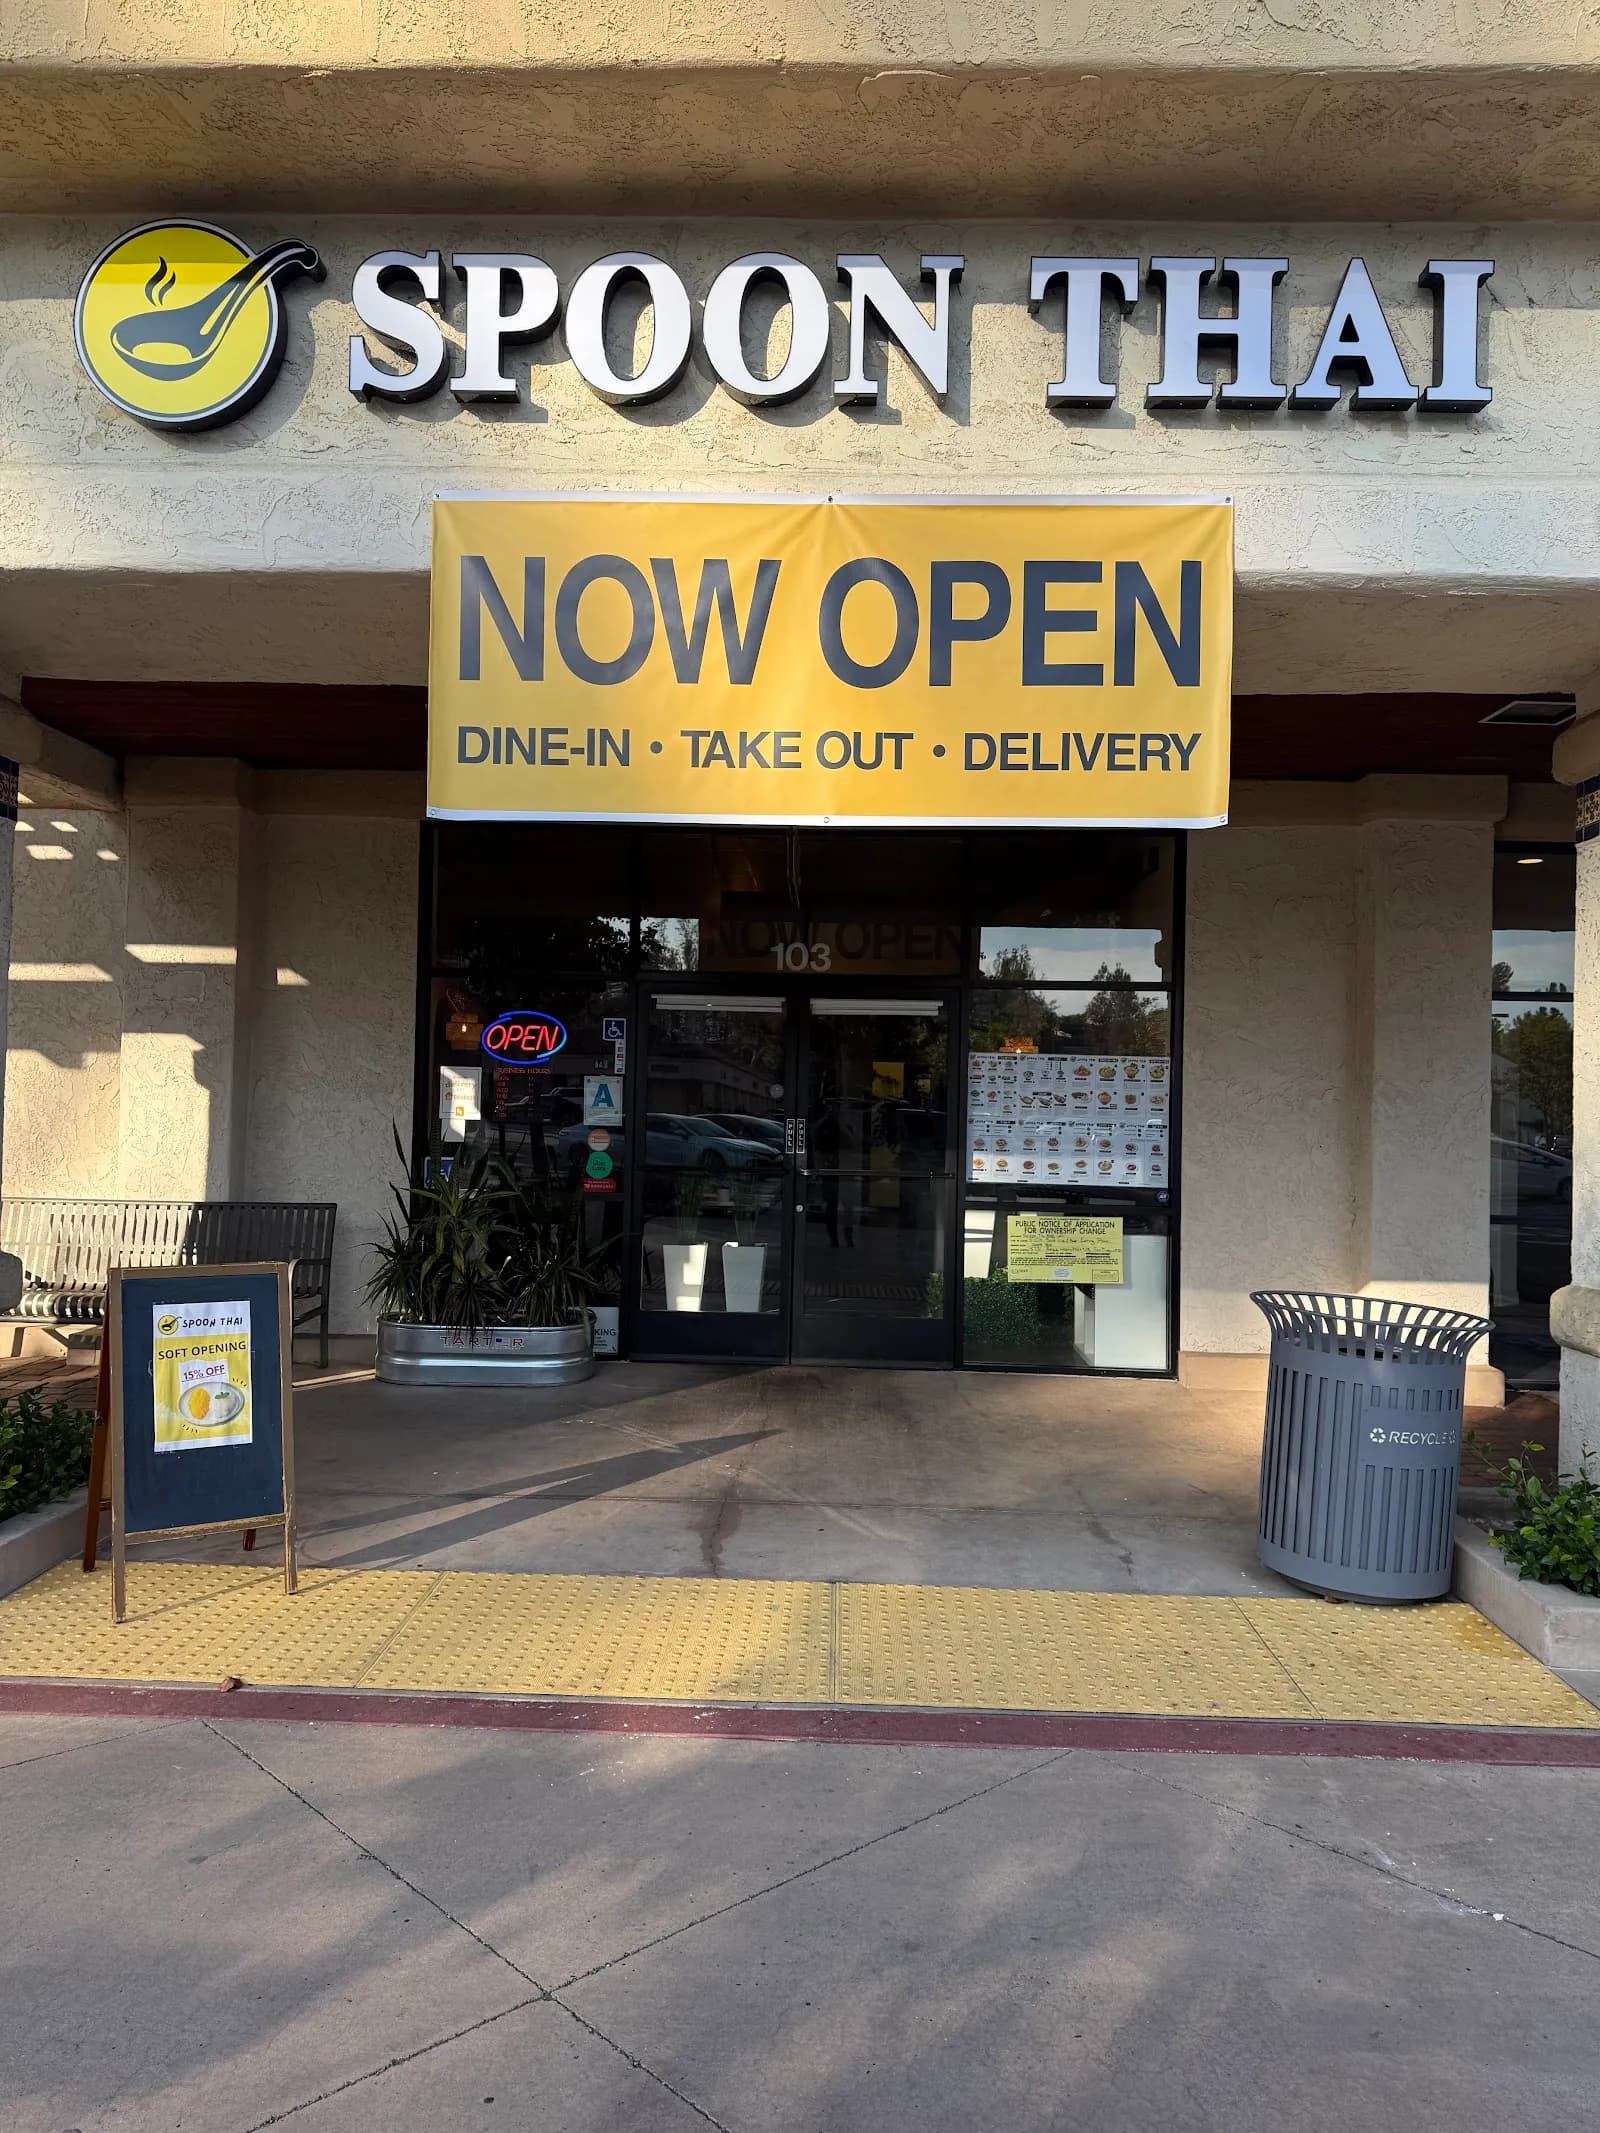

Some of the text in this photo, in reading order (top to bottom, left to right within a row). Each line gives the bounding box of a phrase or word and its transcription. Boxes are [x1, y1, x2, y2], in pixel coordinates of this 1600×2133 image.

[348, 249, 1496, 405] SPOON THAI
[458, 553, 1202, 690] NOW OPEN
[457, 727, 1201, 772] DINE-IN TAKE OUT DELIVERY
[770, 941, 833, 972] 103
[486, 1024, 559, 1051] OPEN
[591, 1083, 614, 1108] A
[1038, 1220, 1061, 1228] NOTICE
[1063, 1220, 1072, 1228] OF
[1075, 1221, 1115, 1229] APPLICATION
[182, 1317, 243, 1328] SPOON THAI
[158, 1341, 247, 1360] SOFT OPENING
[184, 1365, 225, 1381] 15% OFF
